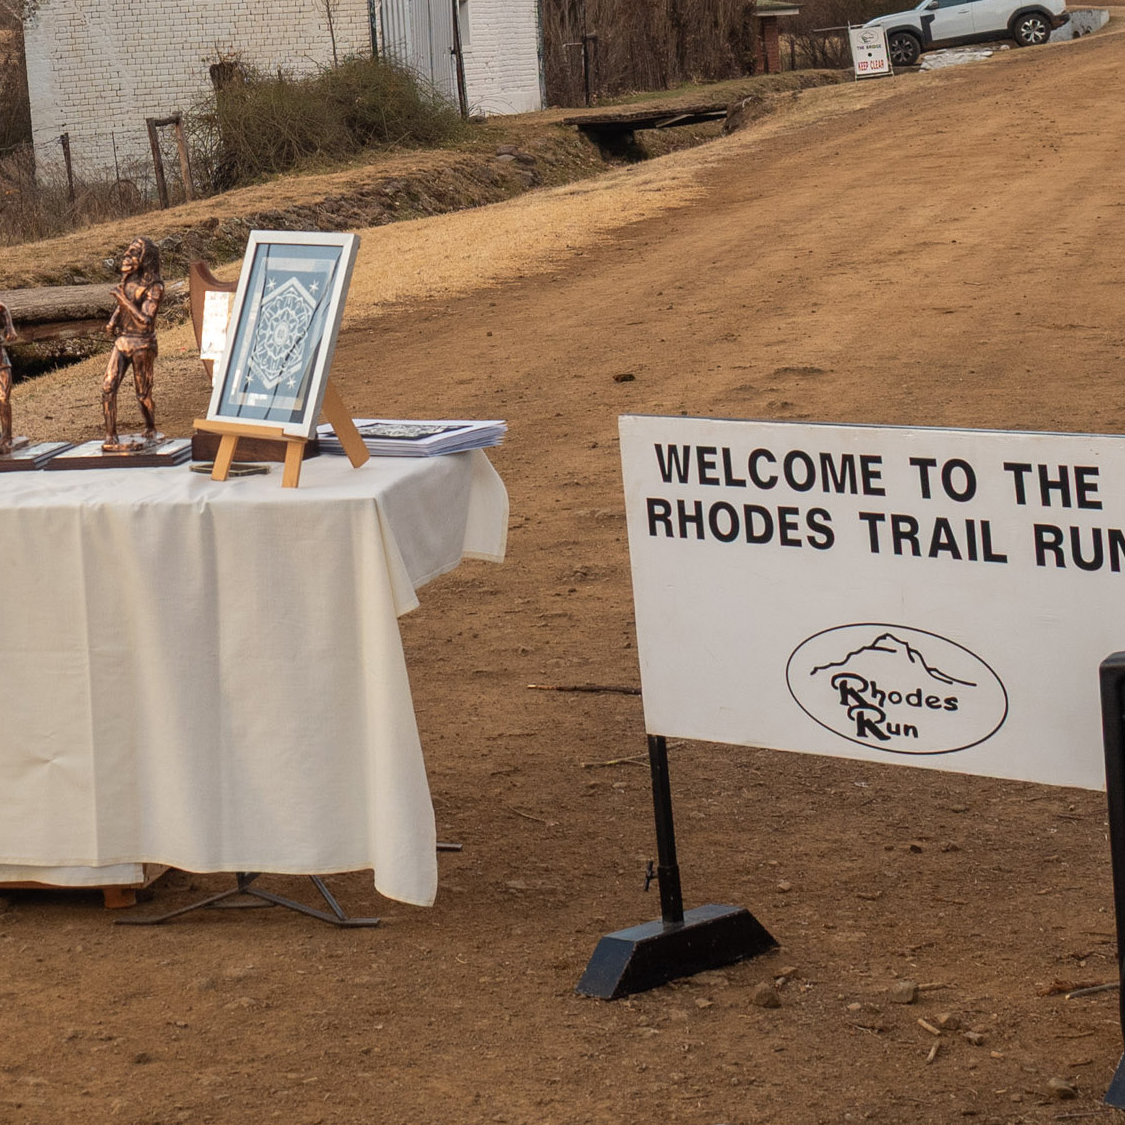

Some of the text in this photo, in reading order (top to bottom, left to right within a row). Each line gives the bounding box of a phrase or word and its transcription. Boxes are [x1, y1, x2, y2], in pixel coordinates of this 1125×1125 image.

[654, 443, 1103, 510] WELCOME TO THE
[646, 497, 835, 550] RHODES
[859, 511, 1008, 564] TRAIL
[831, 672, 959, 711] Rhodes
[848, 704, 919, 741] Run
